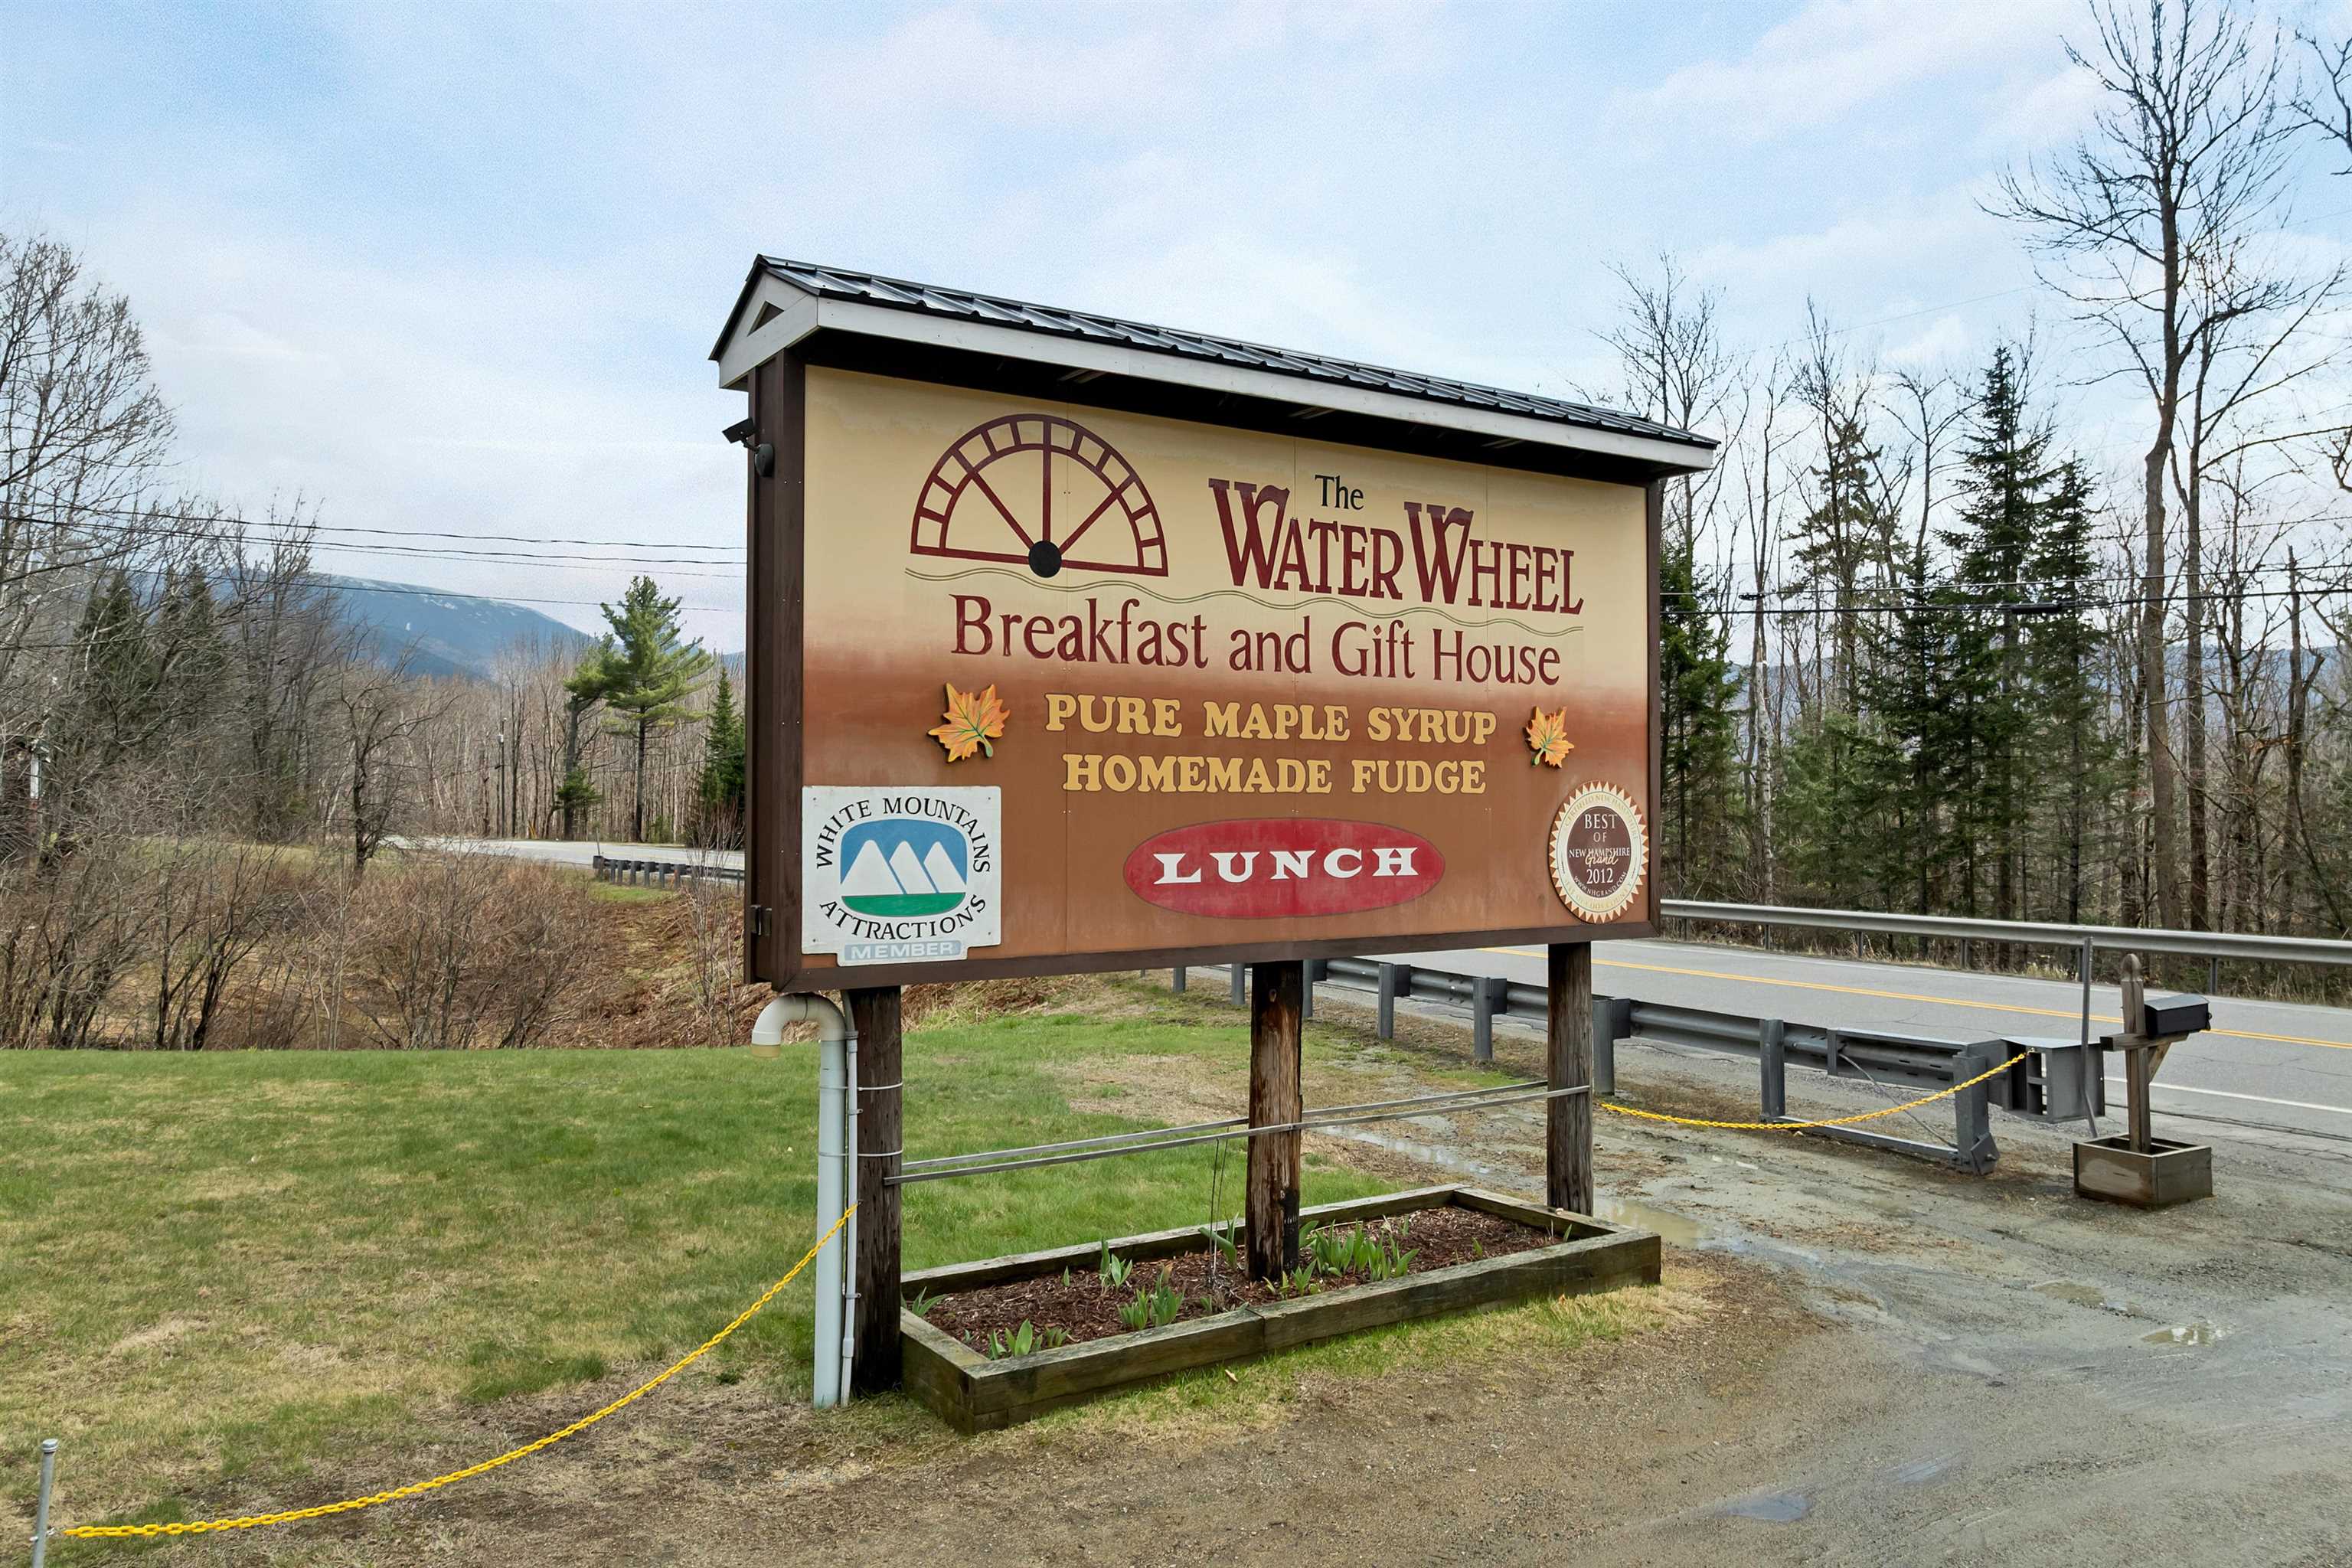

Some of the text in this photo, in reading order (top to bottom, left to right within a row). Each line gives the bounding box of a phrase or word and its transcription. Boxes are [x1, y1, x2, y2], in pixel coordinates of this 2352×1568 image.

[1315, 474, 1364, 511] The
[1208, 478, 1584, 615] WATER WHEEL
[949, 594, 1561, 685] Breakfast and Gift House
[1044, 693, 1498, 745] PURE MAPLE SYRUP
[1062, 753, 1486, 794] HOMEMADE FUDGE
[816, 796, 991, 873] WHITE MOUNTAINS
[1584, 813, 1618, 829] BEST
[1592, 831, 1608, 843] OF
[1153, 847, 1419, 885] LUNCH
[1569, 847, 1630, 858] NEW HAMPSHIRE
[1586, 867, 1614, 885] 2012
[819, 893, 986, 940] ATTRACTIONS
[851, 942, 954, 960] MEMBER
